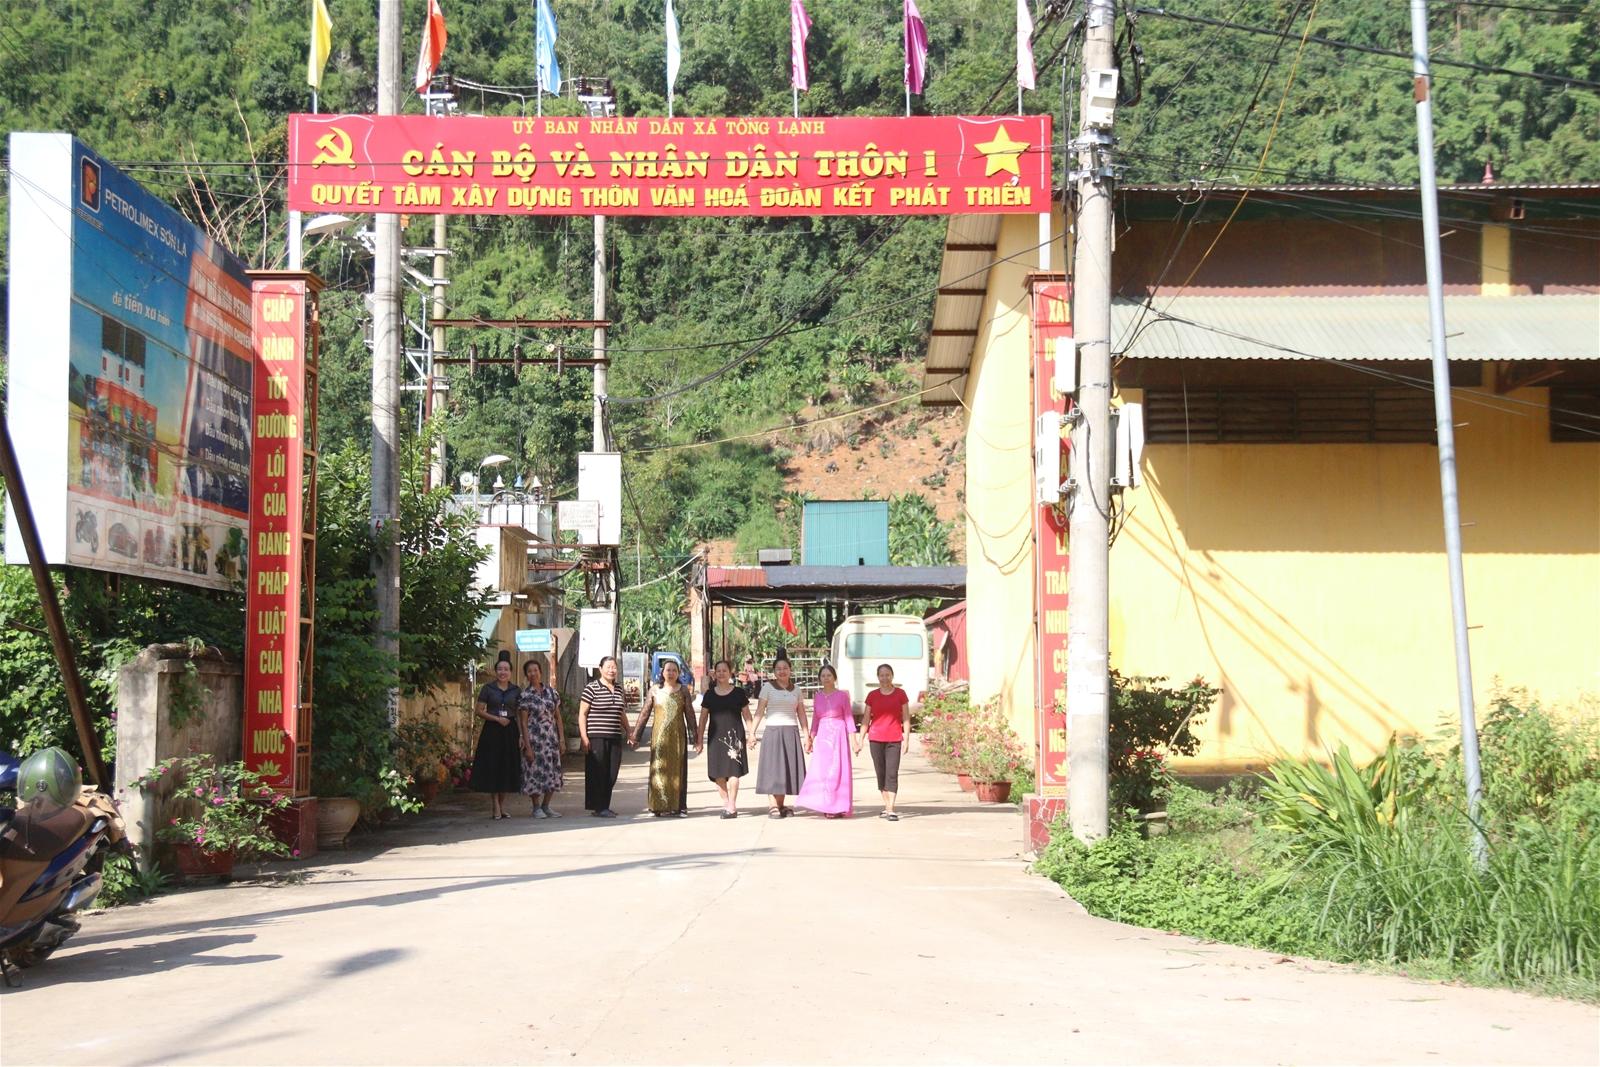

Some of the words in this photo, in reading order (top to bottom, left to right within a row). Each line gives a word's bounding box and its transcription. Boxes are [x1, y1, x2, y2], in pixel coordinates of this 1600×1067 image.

[545, 120, 580, 135] BAN
[590, 114, 639, 135] NHÂN
[777, 119, 826, 137] LẠNH
[402, 142, 479, 178] CÁN
[491, 142, 538, 184] BỘ
[550, 142, 597, 178] VÀ
[608, 142, 710, 179] NHÂN
[724, 143, 801, 179] DÂN
[813, 142, 910, 179] THÔN
[311, 179, 384, 206] QUYẾT
[393, 182, 442, 207] TÂM
[452, 183, 499, 208] XÂY
[507, 184, 573, 211] DỰNG
[580, 184, 643, 208] THÔN
[651, 183, 696, 208] VĂN
[704, 183, 750, 208] HOÁ
[759, 182, 823, 208] ĐOÀN
[832, 181, 876, 208] KẾT
[889, 183, 951, 208] PHÁT
[964, 175, 1032, 207] TRIỂN
[104, 188, 160, 239] PETROLIMEX
[177, 239, 187, 257] LA
[262, 290, 295, 322] CHẤP
[262, 332, 295, 361] HÀNH
[267, 367, 289, 400] TỐT
[257, 409, 298, 439] ĐƯỜNG
[267, 445, 286, 478] LỐI
[262, 482, 287, 517] CỦA
[258, 522, 291, 556] ĐẢNG
[257, 565, 290, 595] PHÁP
[258, 606, 288, 640] LUẬT
[259, 640, 284, 675] CỦA
[258, 685, 283, 714] NHÀ
[253, 722, 286, 755] NƯỚC
